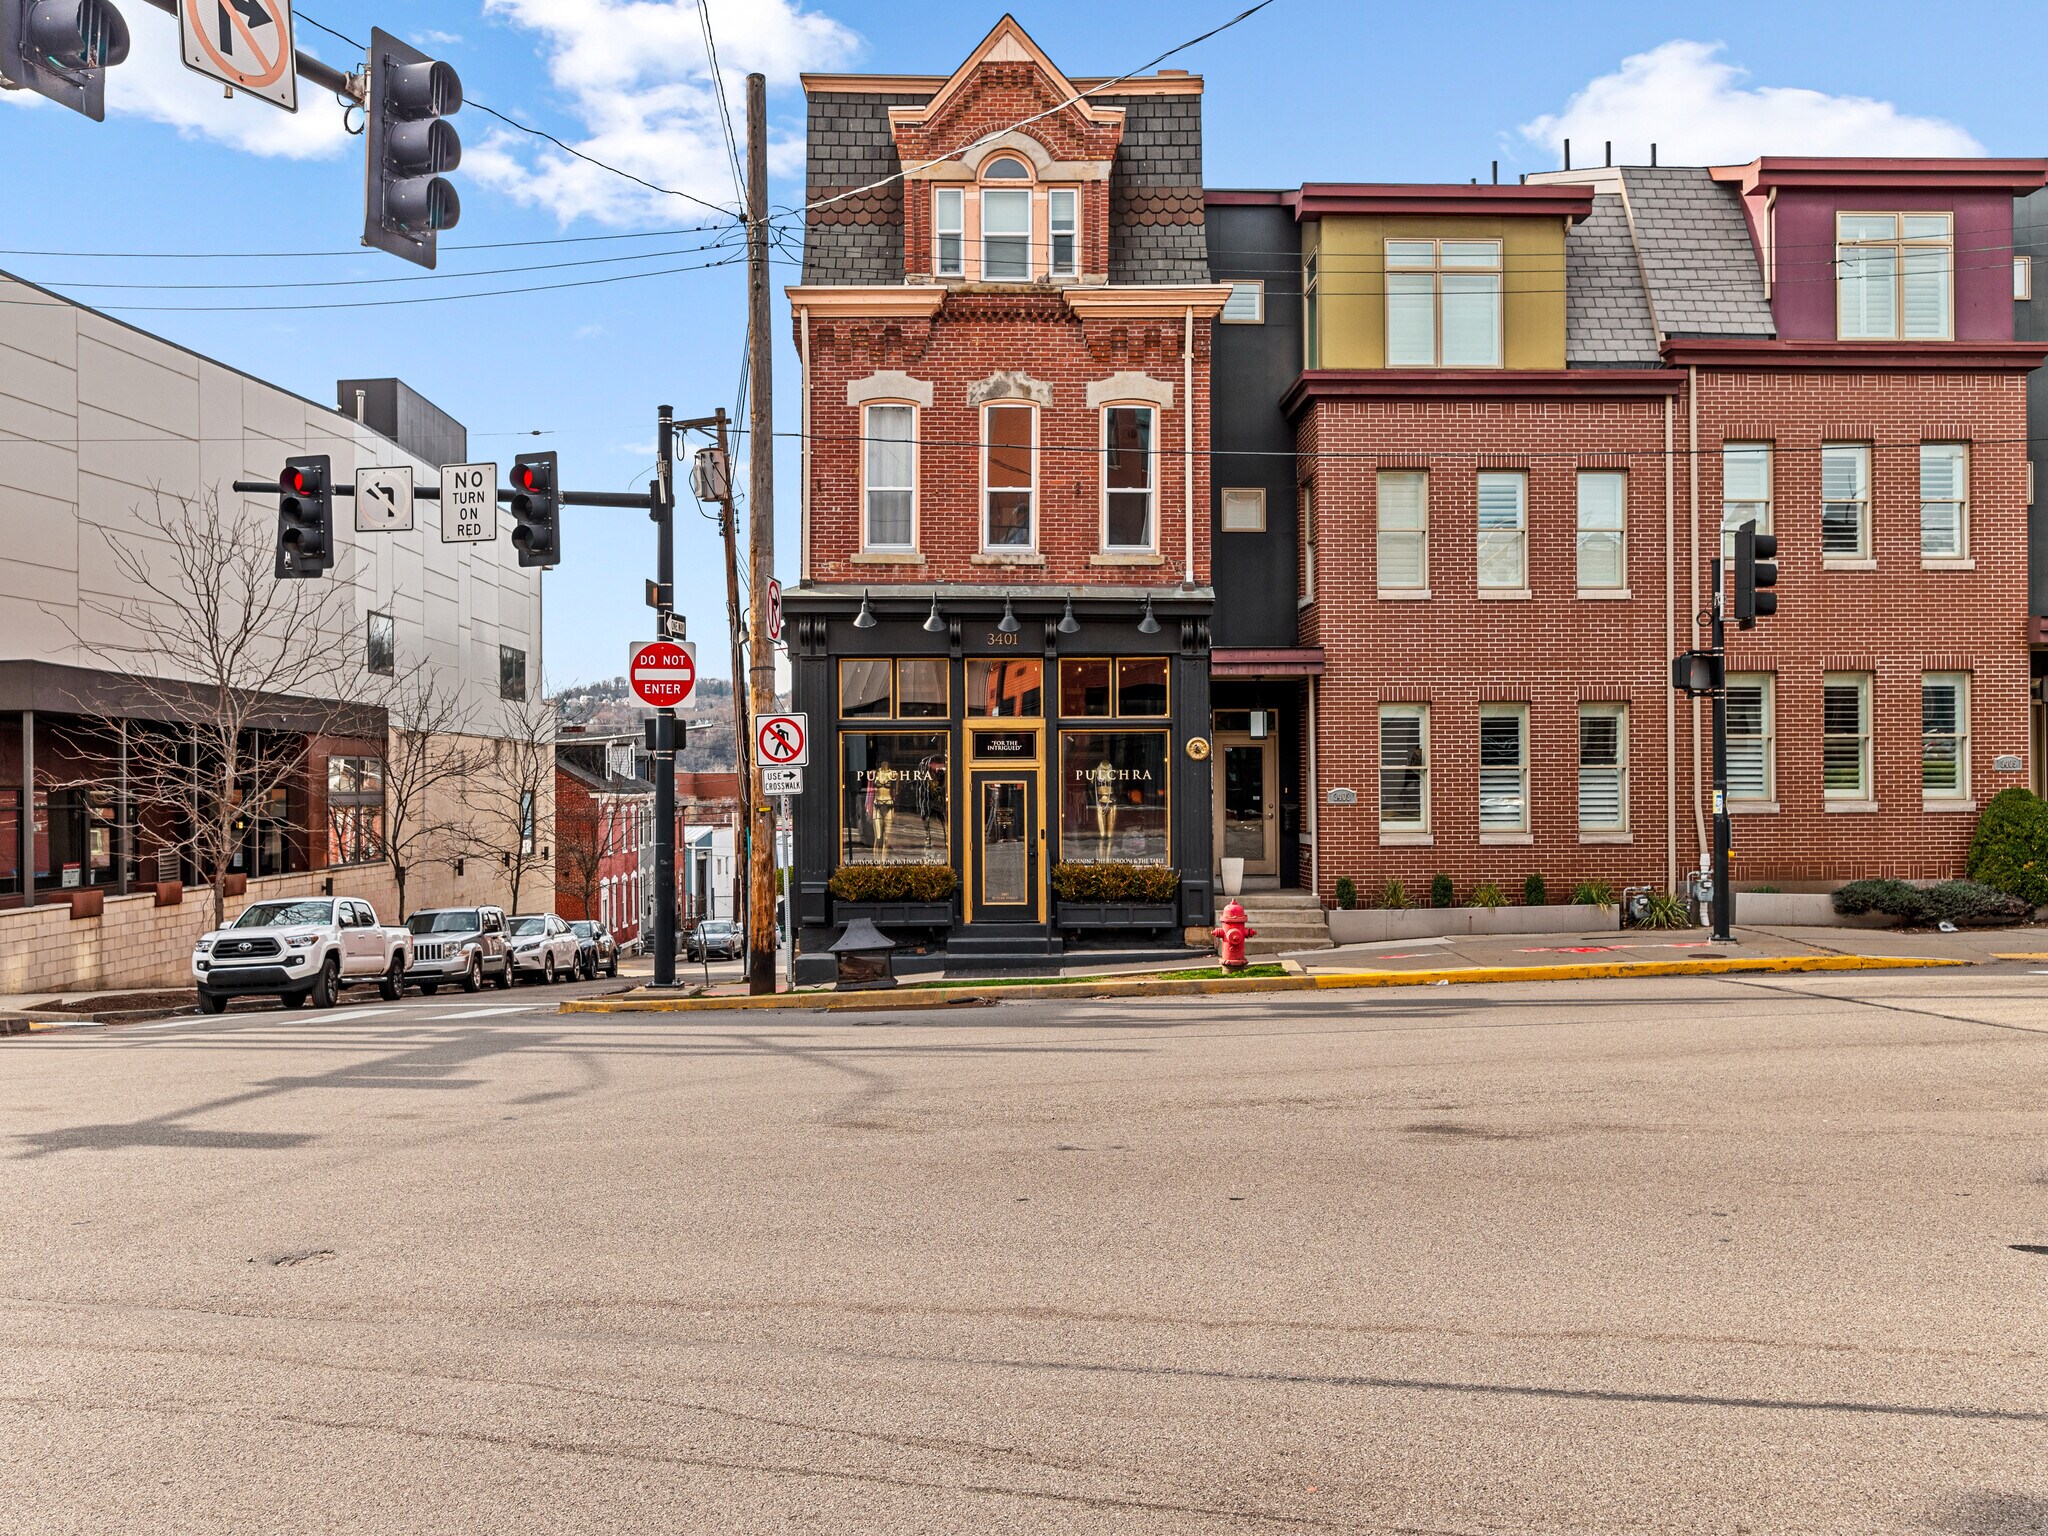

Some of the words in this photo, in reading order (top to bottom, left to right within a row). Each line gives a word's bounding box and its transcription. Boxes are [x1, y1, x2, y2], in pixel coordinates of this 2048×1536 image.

[455, 471, 483, 489] NO
[452, 491, 485, 504] TURN
[460, 508, 478, 520] ON
[457, 524, 481, 536] RED
[987, 633, 1018, 645] 3401
[640, 655, 656, 665] DO
[663, 655, 685, 665] NOT
[644, 684, 680, 694] ENTER
[857, 770, 933, 781] PULCHRA
[1075, 769, 1152, 780] PULCHRA
[765, 782, 800, 791] CROSSWALK
